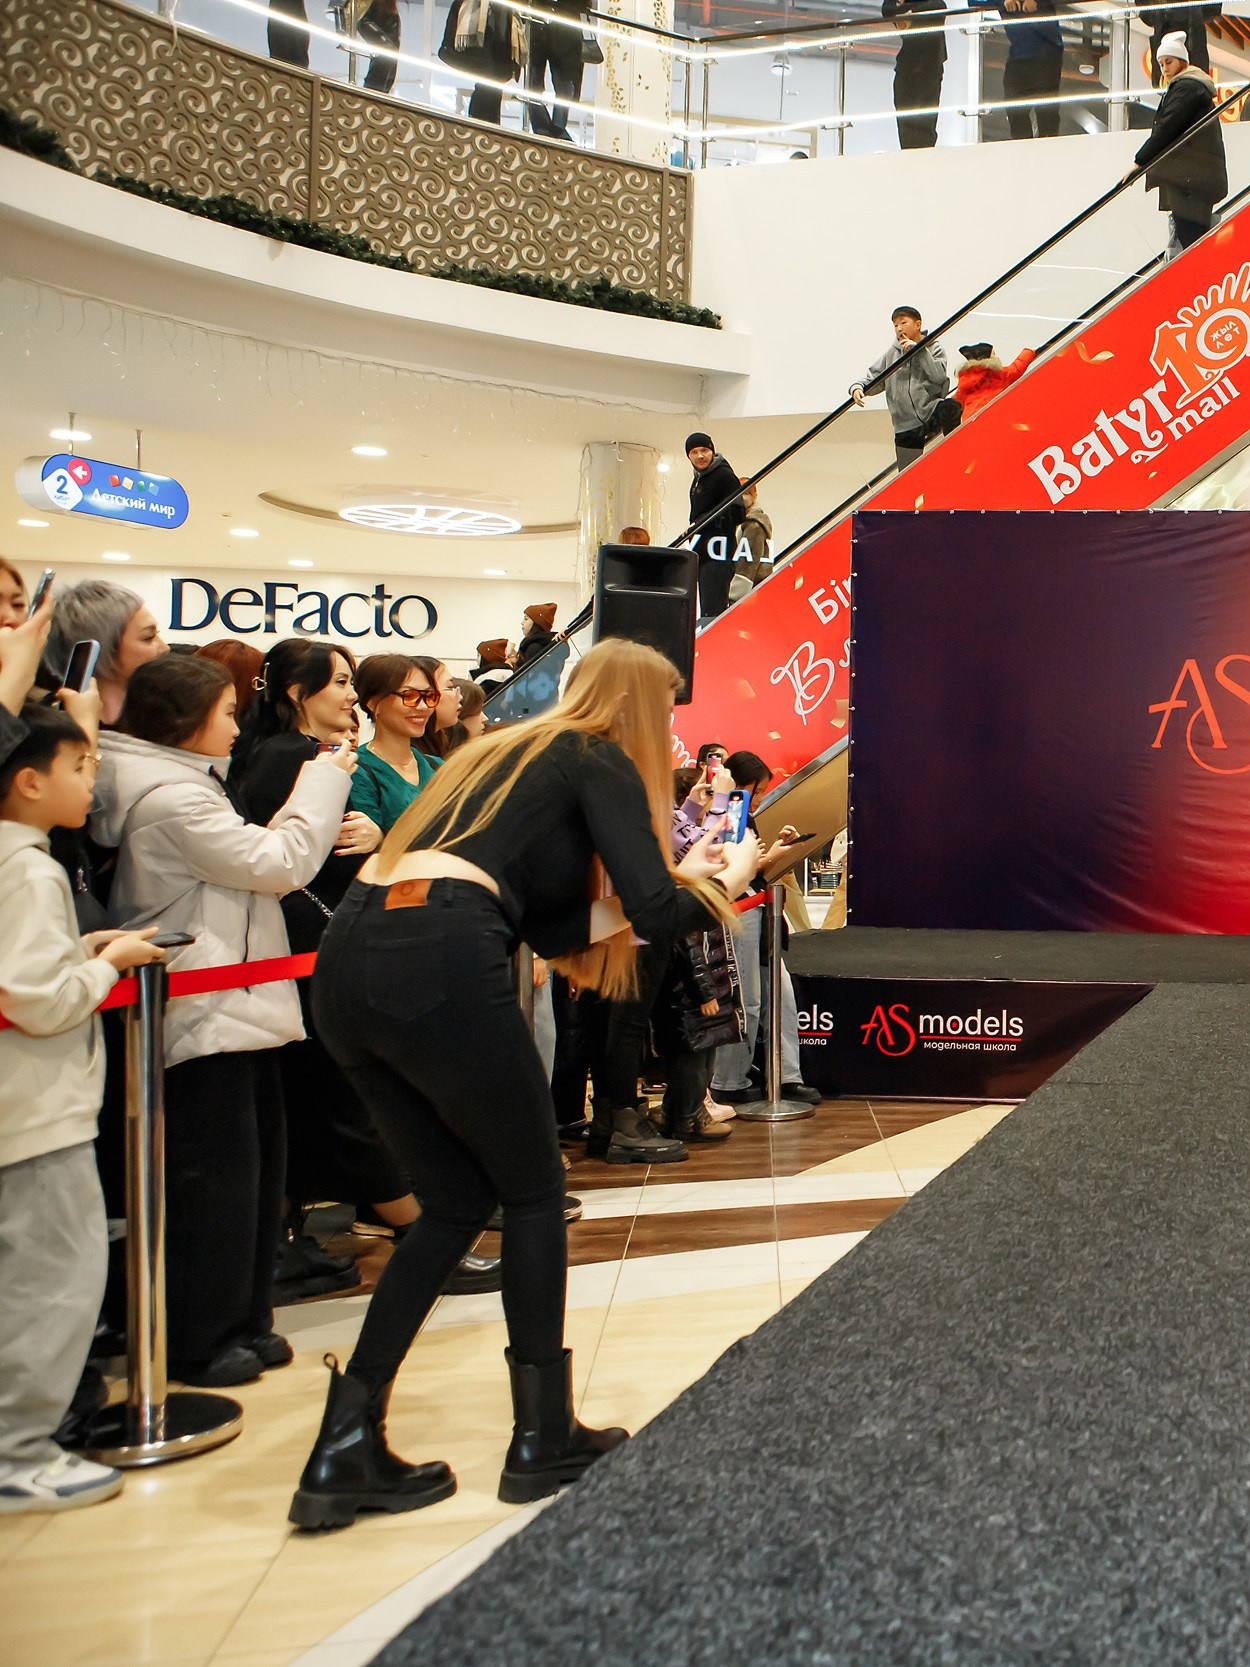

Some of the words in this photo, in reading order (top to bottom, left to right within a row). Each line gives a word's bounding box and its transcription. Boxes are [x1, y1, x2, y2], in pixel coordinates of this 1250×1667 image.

[1210, 320, 1237, 342] ЖЫЛ
[1166, 375, 1241, 442] mall
[1027, 379, 1173, 505] Batyr
[56, 474, 68, 495] 2
[91, 488, 146, 511] Детский
[149, 502, 176, 519] мир
[169, 578, 438, 640] DeFacto
[860, 1003, 916, 1057] AS
[919, 1008, 1024, 1037] models
[923, 1041, 980, 1052] модельная
[983, 1042, 1017, 1052] школа
